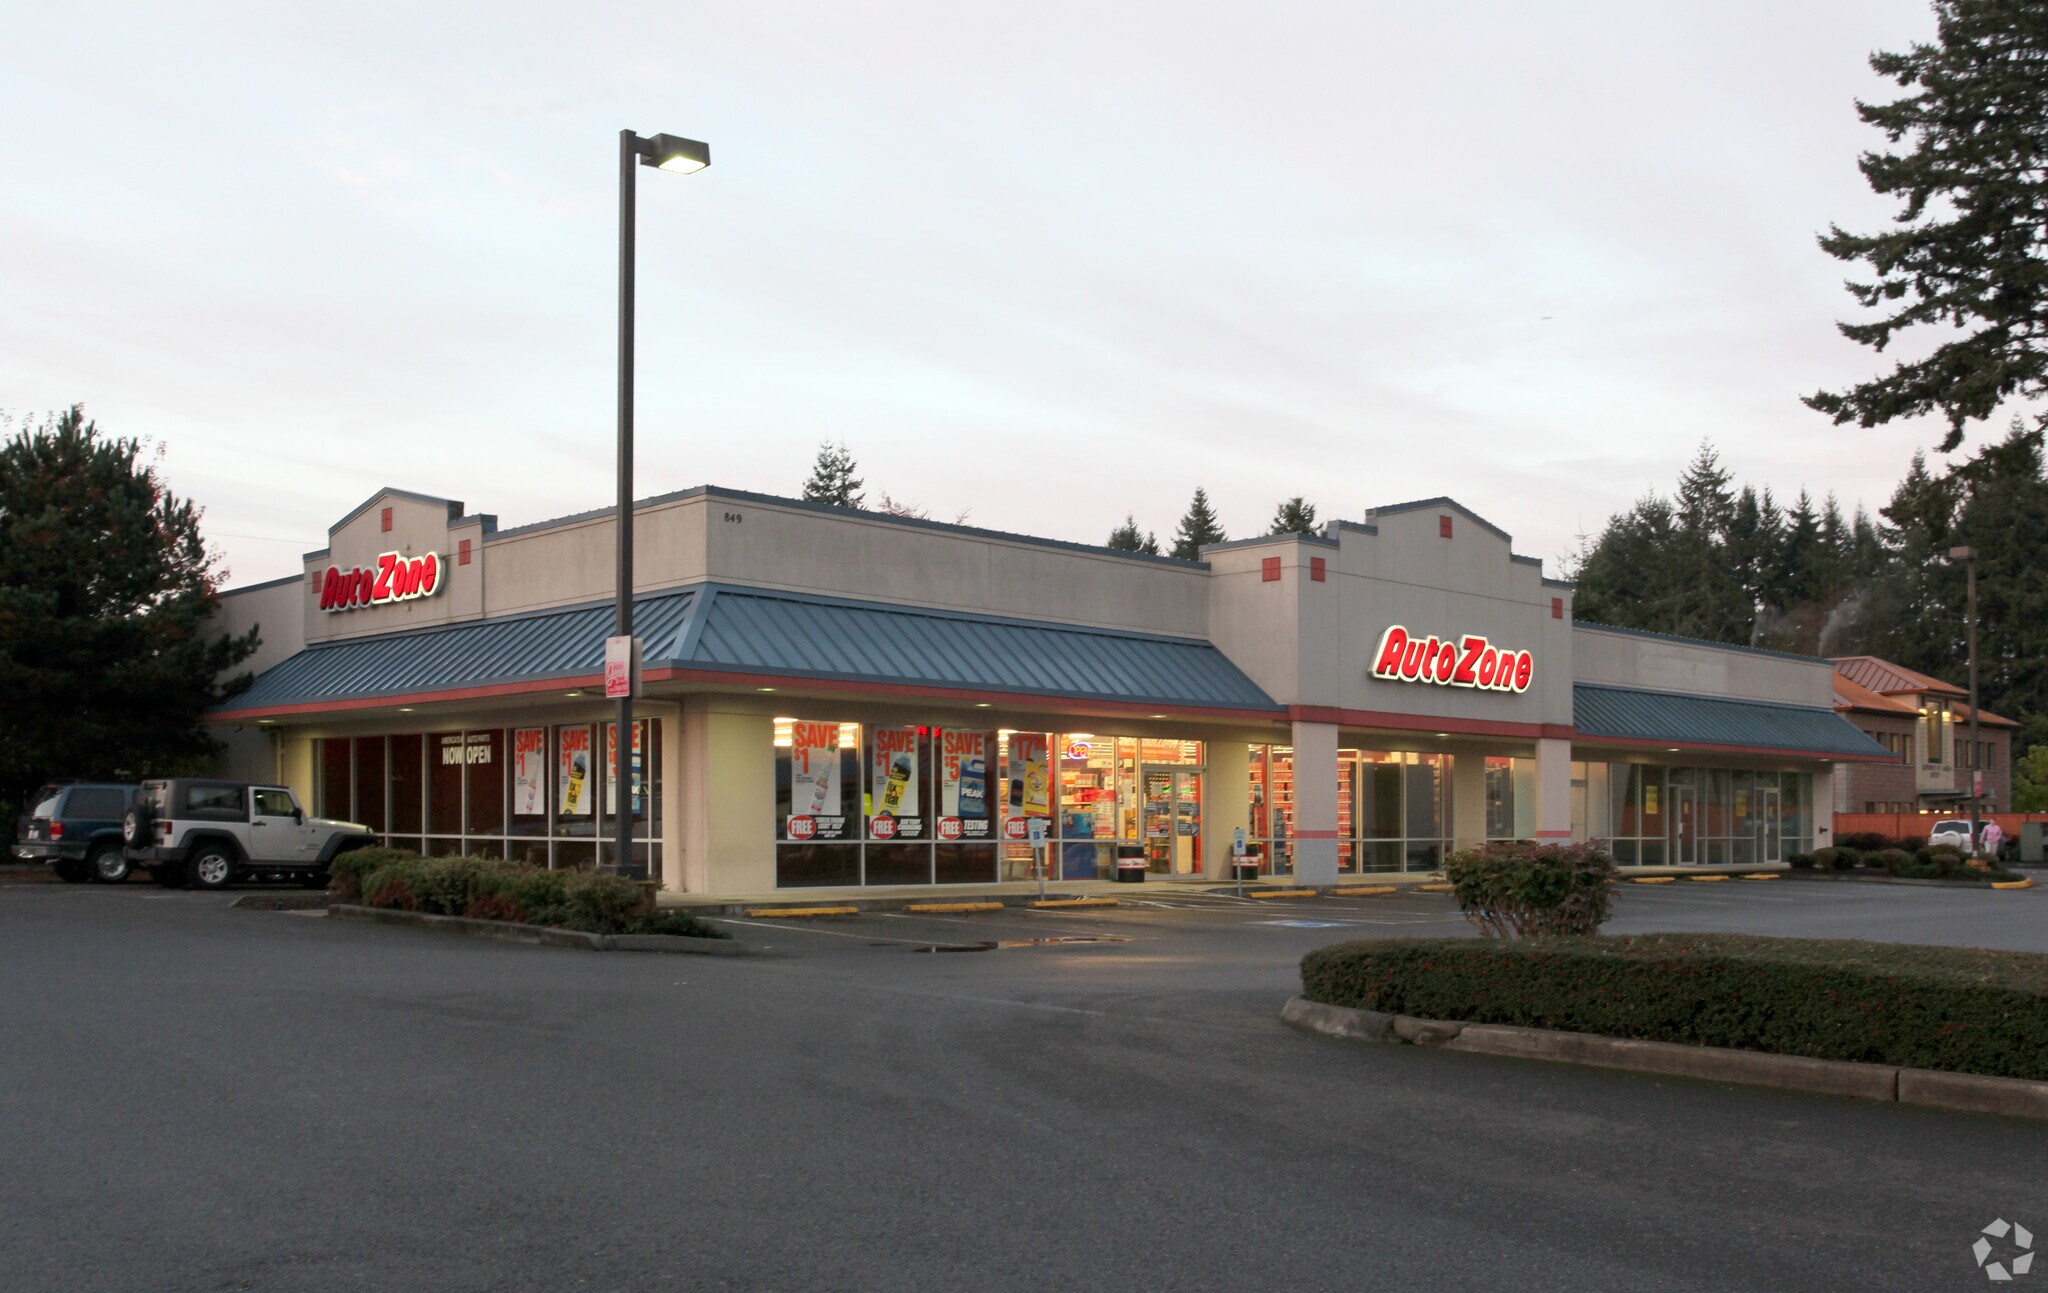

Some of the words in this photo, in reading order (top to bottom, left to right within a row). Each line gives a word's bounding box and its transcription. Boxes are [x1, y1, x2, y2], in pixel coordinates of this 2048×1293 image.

[724, 512, 742, 524] 849
[320, 552, 438, 611] AutoZone
[1375, 627, 1532, 690] AutoZone
[516, 729, 543, 753] SAVE
[560, 729, 589, 752] SAVE
[795, 722, 839, 749] SAVE
[876, 729, 914, 753] SAVE
[944, 731, 983, 756] SAVE
[442, 746, 464, 765] NOW
[466, 745, 491, 764] OPEN
[516, 752, 525, 777] $1
[562, 751, 572, 776] $1
[794, 747, 809, 774] $1
[876, 751, 891, 776] $1
[944, 755, 960, 781] $5
[961, 788, 984, 799] PEAK
[791, 820, 812, 835] FREE
[873, 820, 894, 835] FREE
[941, 820, 960, 835] FREE
[964, 820, 989, 831] TESTING
[1007, 821, 1026, 835] FREE
